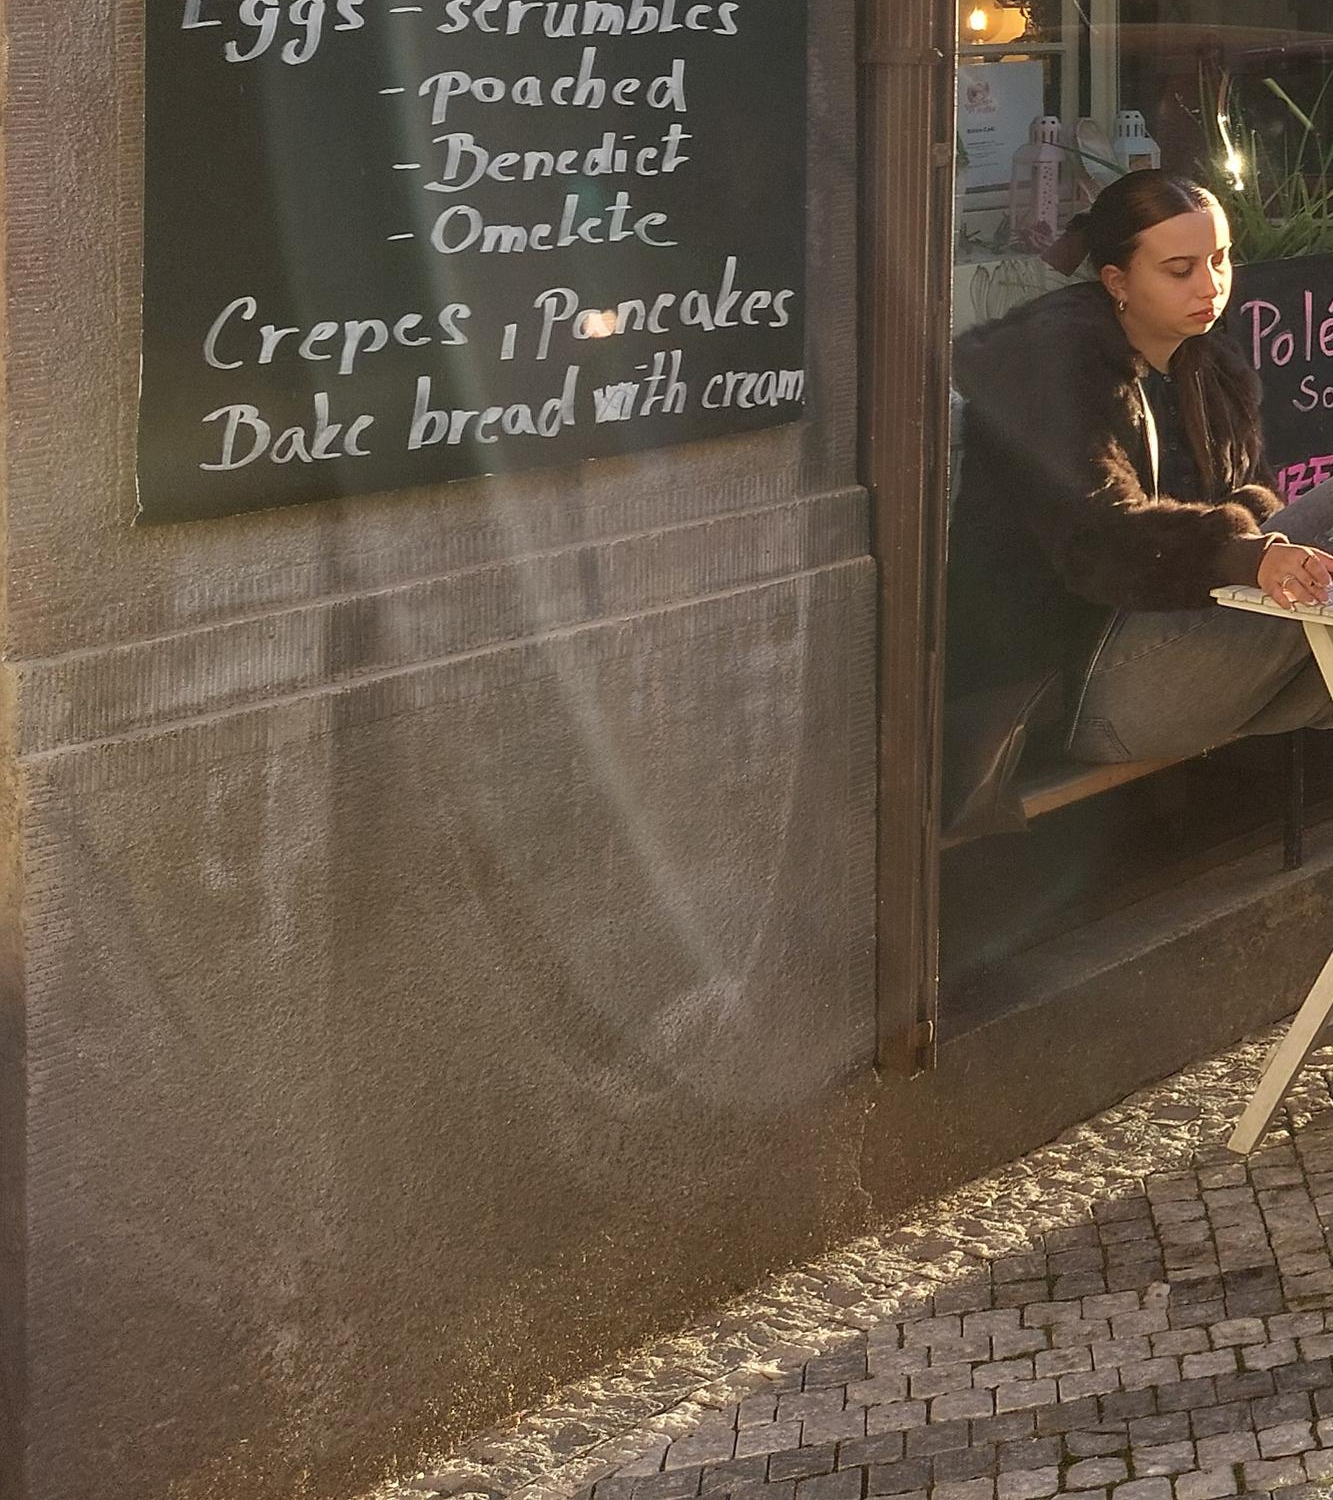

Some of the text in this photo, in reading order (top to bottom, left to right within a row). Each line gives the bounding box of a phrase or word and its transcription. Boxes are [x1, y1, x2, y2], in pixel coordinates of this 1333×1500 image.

[418, 46, 688, 125] poached
[424, 123, 693, 192] Benedict
[535, 256, 795, 360] Pancakes
[409, 365, 580, 451] bread
[593, 348, 687, 424] with
